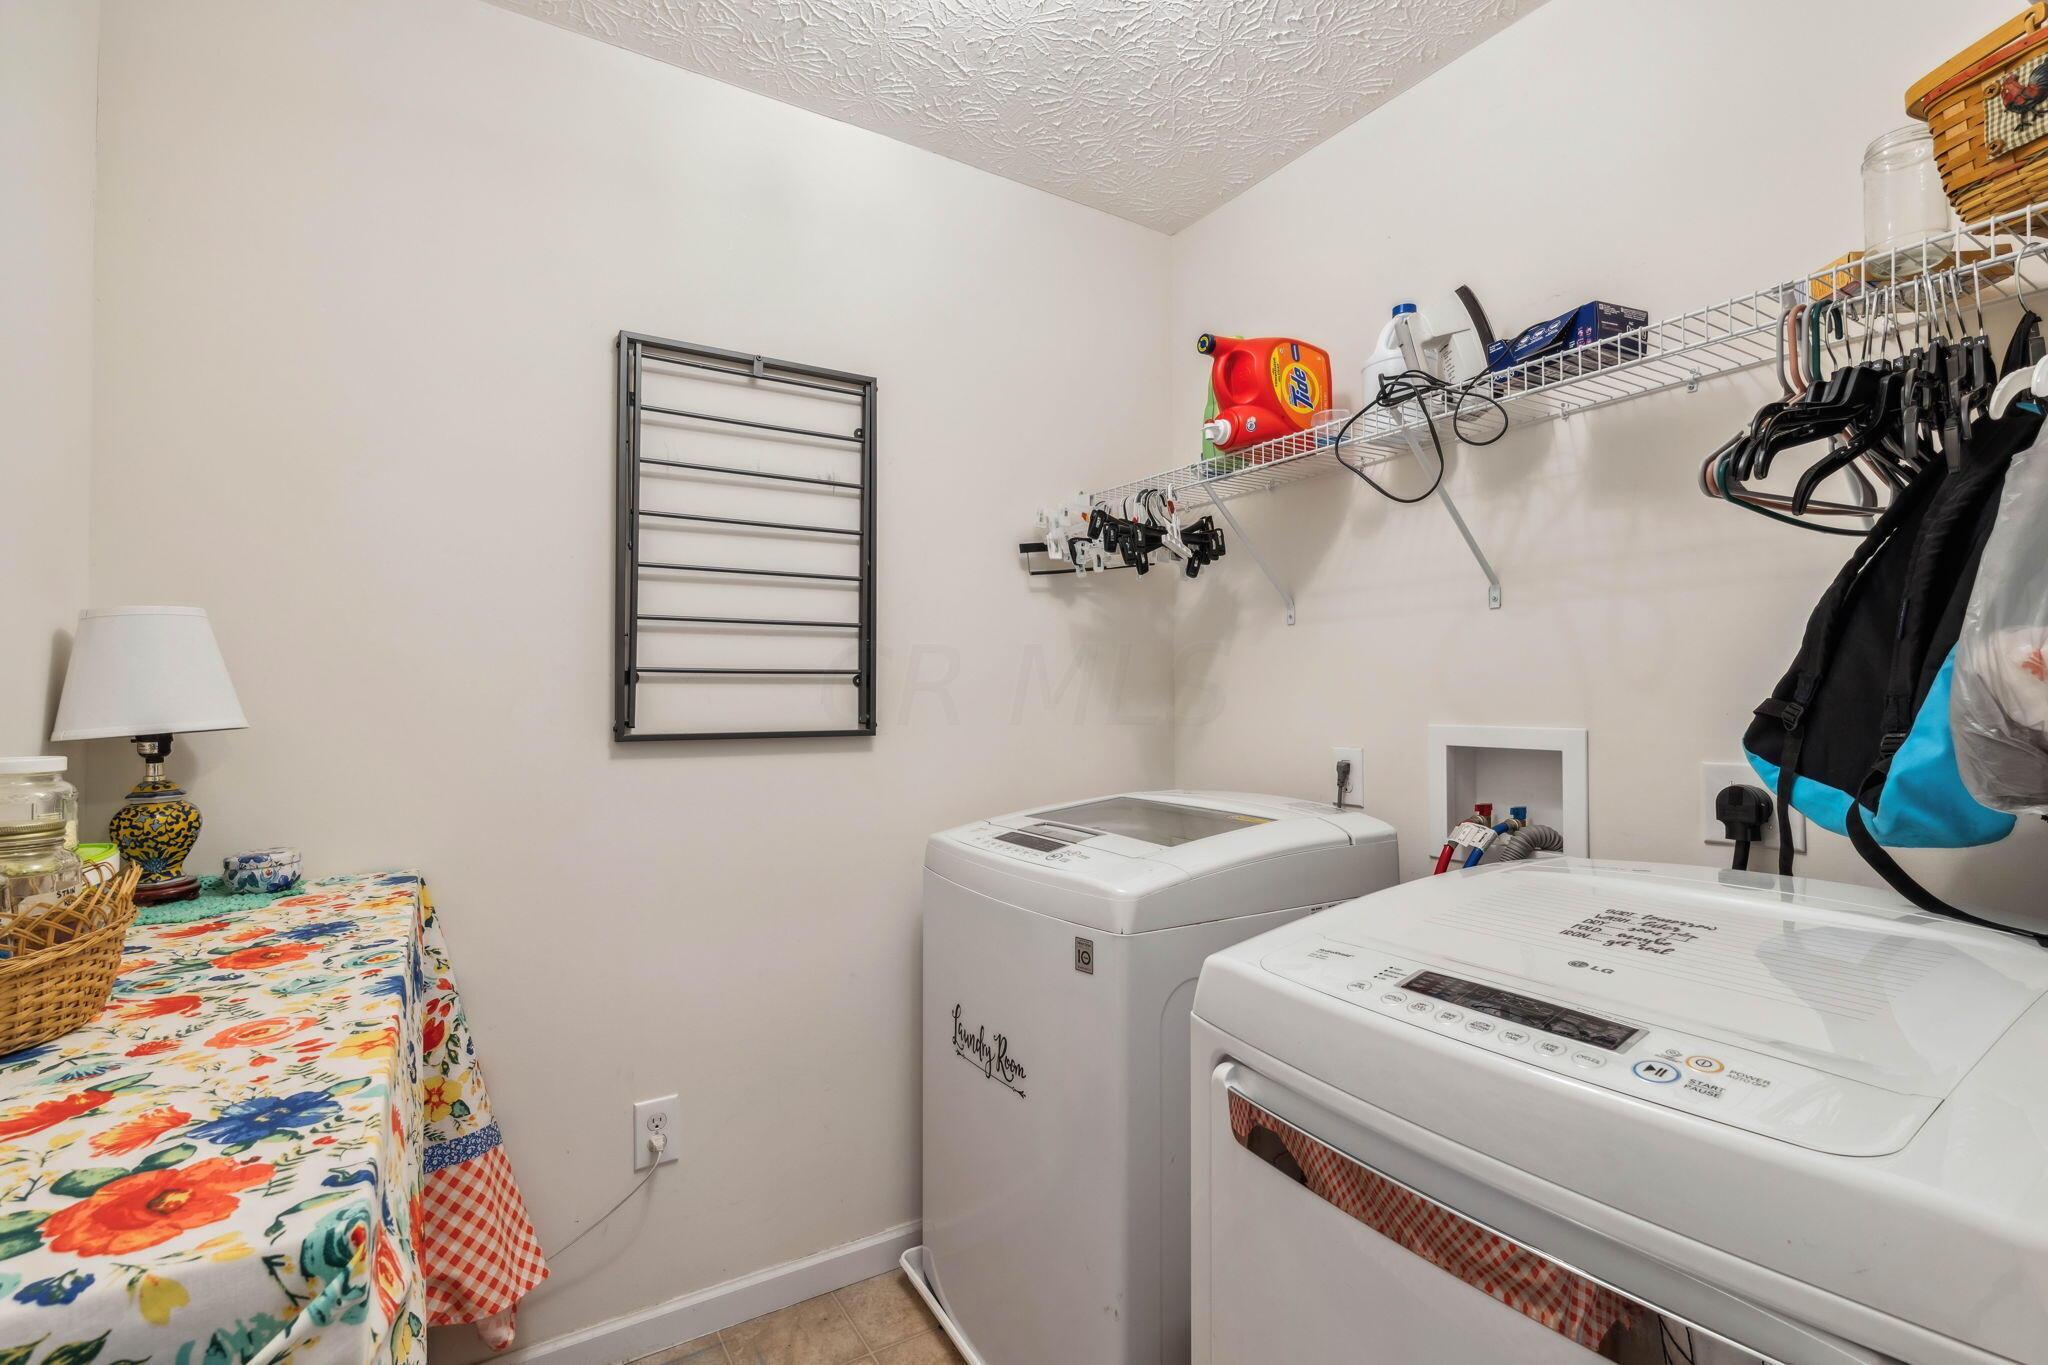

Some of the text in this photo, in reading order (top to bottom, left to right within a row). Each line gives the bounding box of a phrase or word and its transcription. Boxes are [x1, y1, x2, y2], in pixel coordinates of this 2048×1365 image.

[1289, 366, 1315, 411] Tide
[57, 886, 75, 899] STAIN
[1590, 965, 1615, 975] LG
[952, 1003, 1027, 1083] Laundry Room
[1688, 1078, 1726, 1093] START
[1729, 1070, 1771, 1086] POWER
[1684, 1084, 1722, 1099] PAUSE
